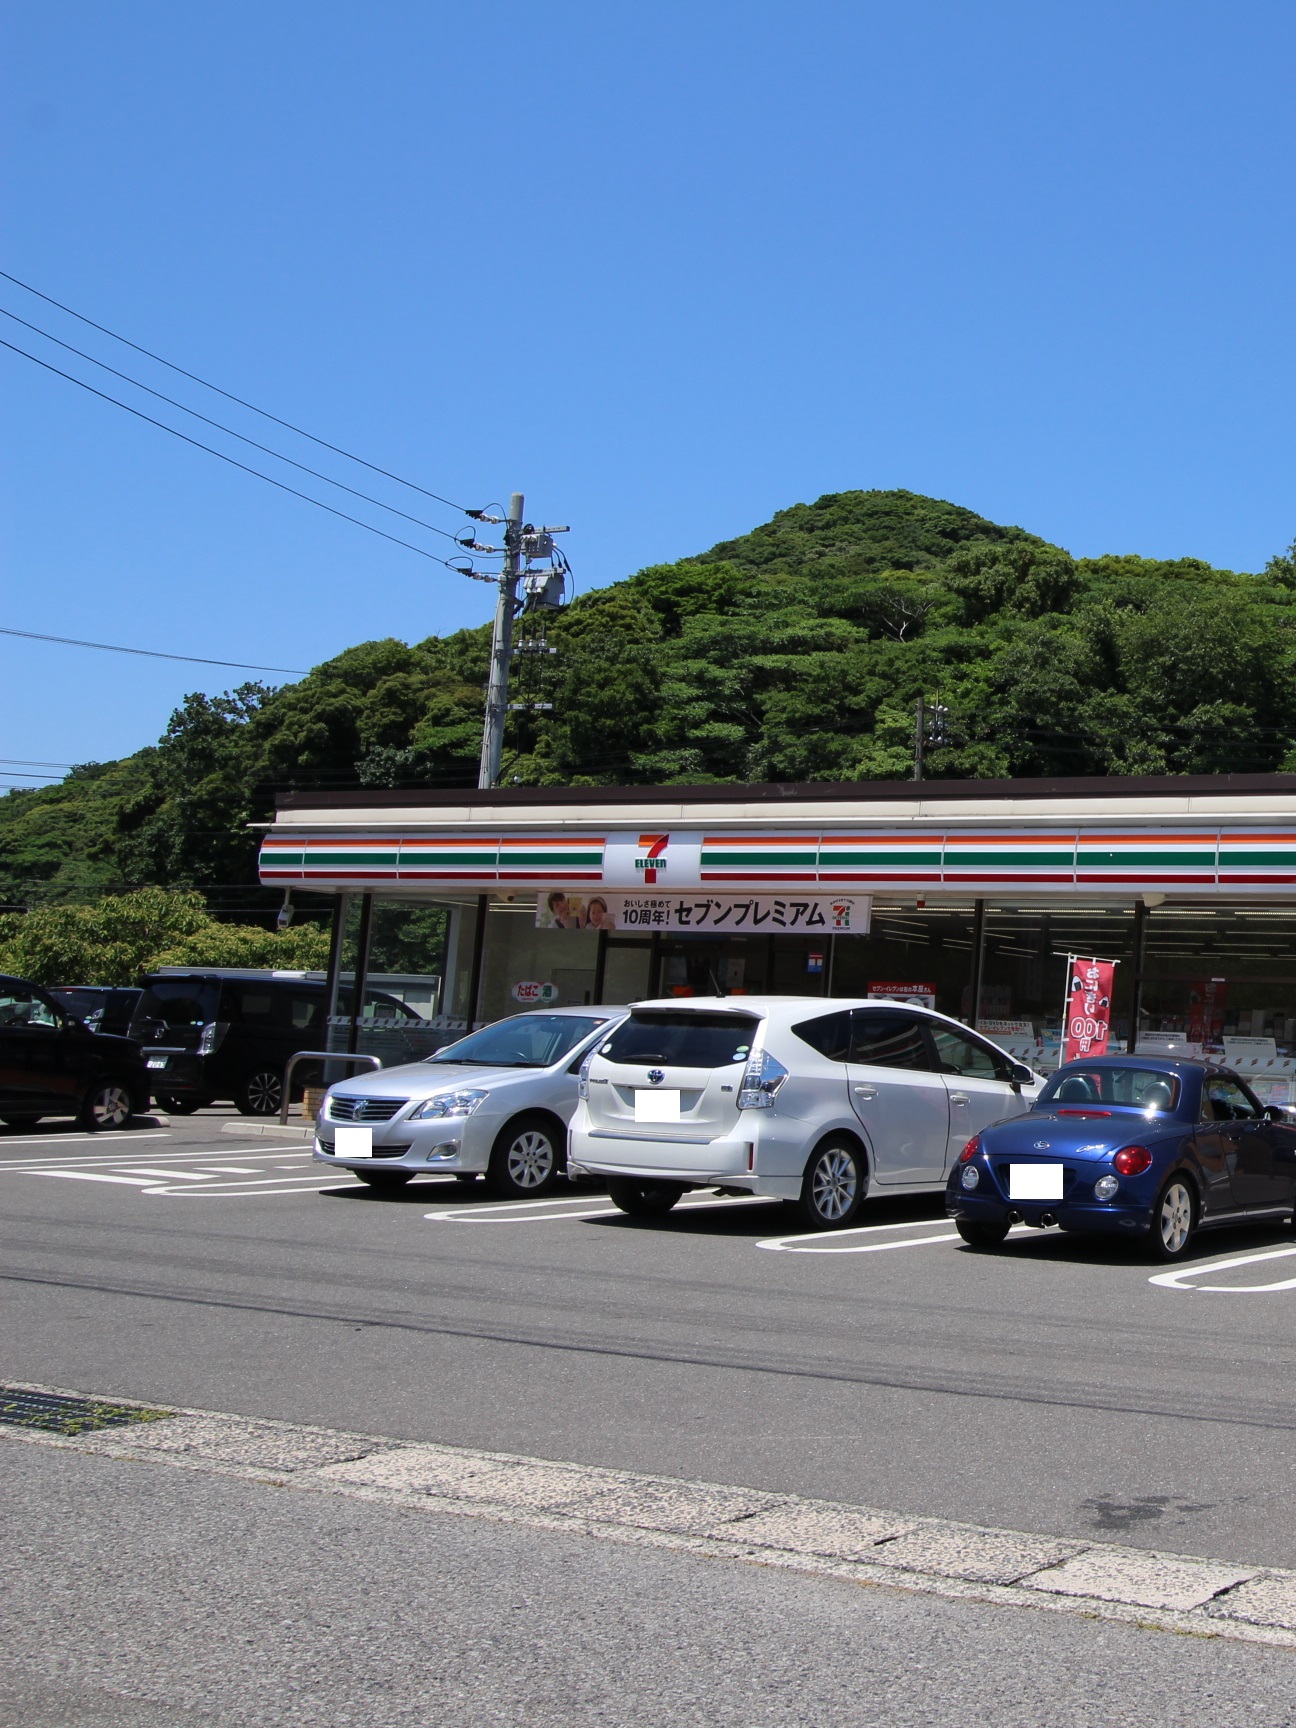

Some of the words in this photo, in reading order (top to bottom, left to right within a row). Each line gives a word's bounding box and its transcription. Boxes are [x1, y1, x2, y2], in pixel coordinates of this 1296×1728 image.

[638, 834, 669, 883] 7
[623, 899, 672, 909] おいしさ極めて
[674, 899, 826, 927] セブンプレミアム
[622, 908, 671, 926] 10周年!
[517, 984, 539, 997] たばこ
